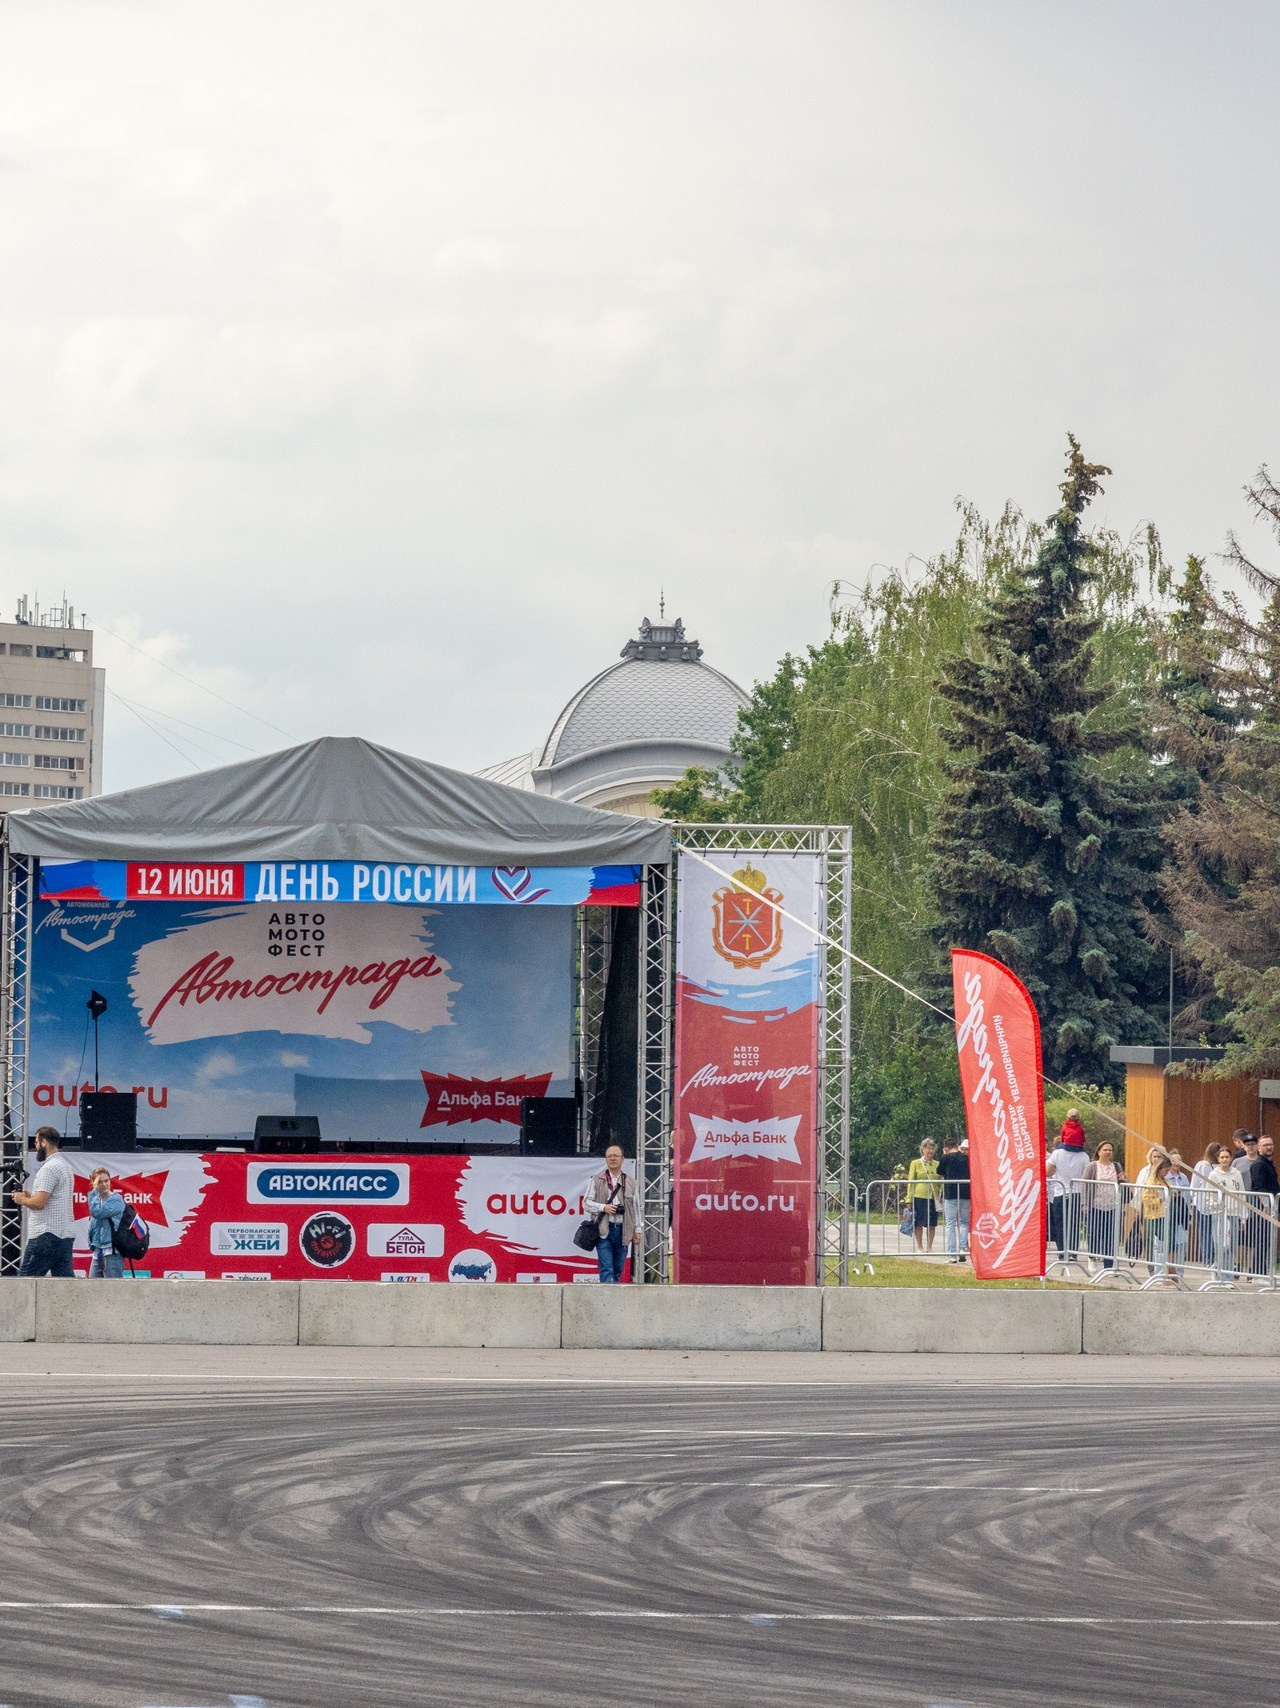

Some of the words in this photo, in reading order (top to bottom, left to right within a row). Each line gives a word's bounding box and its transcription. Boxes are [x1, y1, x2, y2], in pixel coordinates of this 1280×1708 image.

[137, 868, 162, 895] 12
[169, 868, 234, 896] ИЮНЯ
[255, 863, 340, 903] ДЕНЬ
[353, 864, 477, 903] РОССИИ
[34, 907, 137, 934] Автострада
[268, 912, 325, 926] АВТО
[268, 928, 325, 942] МОТО
[268, 944, 325, 958] ФЕСТ
[147, 951, 442, 1027] Автострада
[680, 1063, 812, 1097] Автострада
[437, 1090, 491, 1110] Альфа
[495, 1091, 536, 1106] Бан
[704, 1130, 750, 1147] Альфа
[752, 1131, 787, 1144] Банк
[268, 1175, 388, 1192] АВТОКЛАСС
[486, 1189, 584, 1216] auto.r
[695, 1191, 795, 1212] auto.ru
[234, 1239, 280, 1250] ЖБИ
[386, 1241, 425, 1254] БЕТОН
